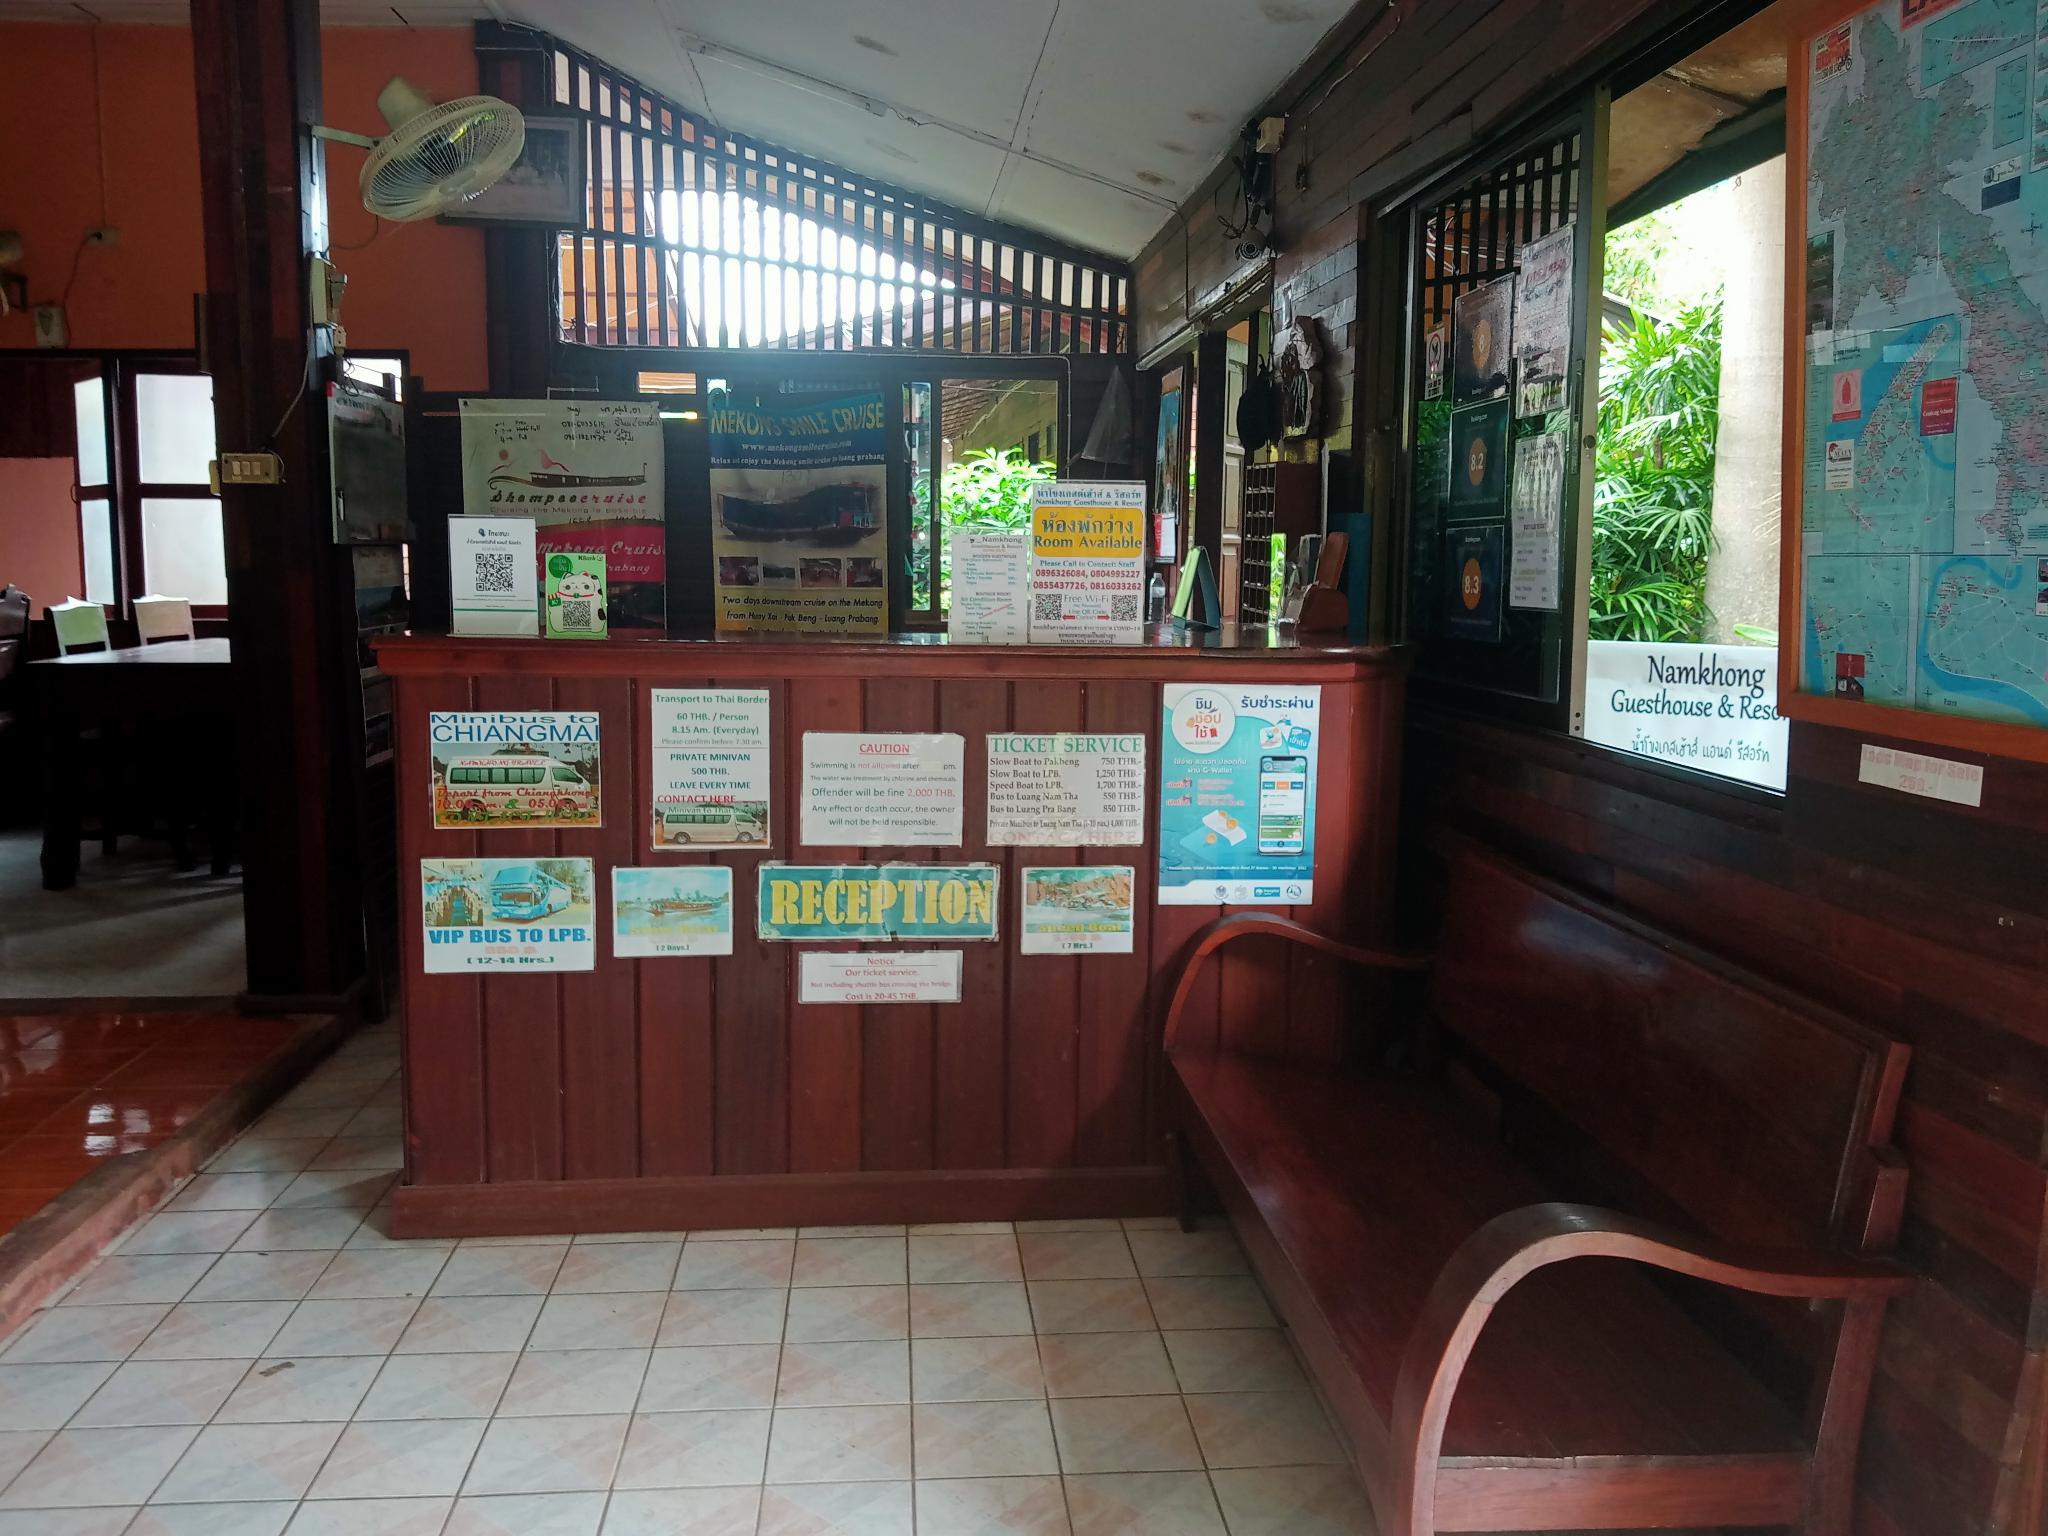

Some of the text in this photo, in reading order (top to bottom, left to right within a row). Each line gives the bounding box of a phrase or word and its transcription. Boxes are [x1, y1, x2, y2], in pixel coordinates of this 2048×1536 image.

[831, 402, 885, 433] CRUISE
[1470, 453, 1484, 472] 8.2
[1035, 498, 1072, 507] Namkhong
[1041, 511, 1134, 534] ห้องพักว่าง
[982, 536, 1023, 544] Namkhong
[1034, 535, 1143, 549] Room Available
[1118, 560, 1137, 568] Staff
[1464, 577, 1480, 594] 8.3
[722, 596, 741, 604] Two
[744, 596, 760, 606] days
[762, 597, 801, 606] downstream
[804, 598, 826, 607] cruise
[839, 598, 851, 607] the
[853, 598, 883, 609] Mekong
[1648, 652, 1766, 699] Namkhong
[655, 694, 769, 705] Transport to Thai Border
[1195, 697, 1213, 710] ชิม
[1241, 695, 1314, 710] รับชำระผ่าน
[1611, 688, 1787, 721] Guesthouse & Reso
[431, 714, 597, 724] Minibus to
[719, 712, 749, 720] Person
[433, 725, 600, 742] CHIANGMAI
[672, 725, 759, 736] 8.15 Am. (Everyday)
[1194, 724, 1209, 739] ใช้
[859, 743, 910, 753] CAUTION
[991, 737, 1143, 753] TICKET SERVICE
[1702, 738, 1733, 759] แอนด์
[1736, 740, 1770, 762] รีสอร์ท
[811, 762, 849, 771] Swimming
[849, 762, 857, 770] is
[858, 762, 870, 770] not
[902, 762, 920, 770] after
[989, 758, 1011, 766] Slow
[1013, 758, 1031, 766] Boat
[1032, 758, 1042, 766] to
[1043, 757, 1080, 767] Pakbeng
[1101, 758, 1115, 766] 750
[989, 770, 1010, 778] Slow
[1013, 770, 1031, 778] Boat
[1032, 770, 1041, 778] to
[1042, 770, 1061, 778] LPB.
[1095, 769, 1116, 779] 1,250
[989, 781, 1014, 791] Speed
[1045, 782, 1063, 790] LPB.
[1097, 781, 1117, 791] 1,700
[436, 787, 480, 799] Depart
[481, 787, 513, 799] from
[811, 788, 853, 797] Offender
[855, 788, 871, 797] will
[873, 788, 885, 797] be
[887, 788, 905, 797] fine
[907, 788, 933, 798] 2,000
[657, 795, 737, 804] CONTACT HERE
[812, 805, 827, 814] Any
[829, 805, 853, 813] effect
[864, 805, 888, 813] death
[889, 806, 913, 814] occur,
[915, 805, 928, 813] the
[990, 805, 1005, 813] Bus
[1006, 805, 1015, 813] to
[1016, 805, 1041, 814] Luang
[1042, 805, 1055, 813] Pra
[1057, 805, 1077, 814] Bang
[891, 818, 937, 827] responsible.
[770, 880, 993, 925] RECEPTION
[428, 928, 592, 944] VIP BUS TO LPB.
[867, 957, 895, 965] Notice
